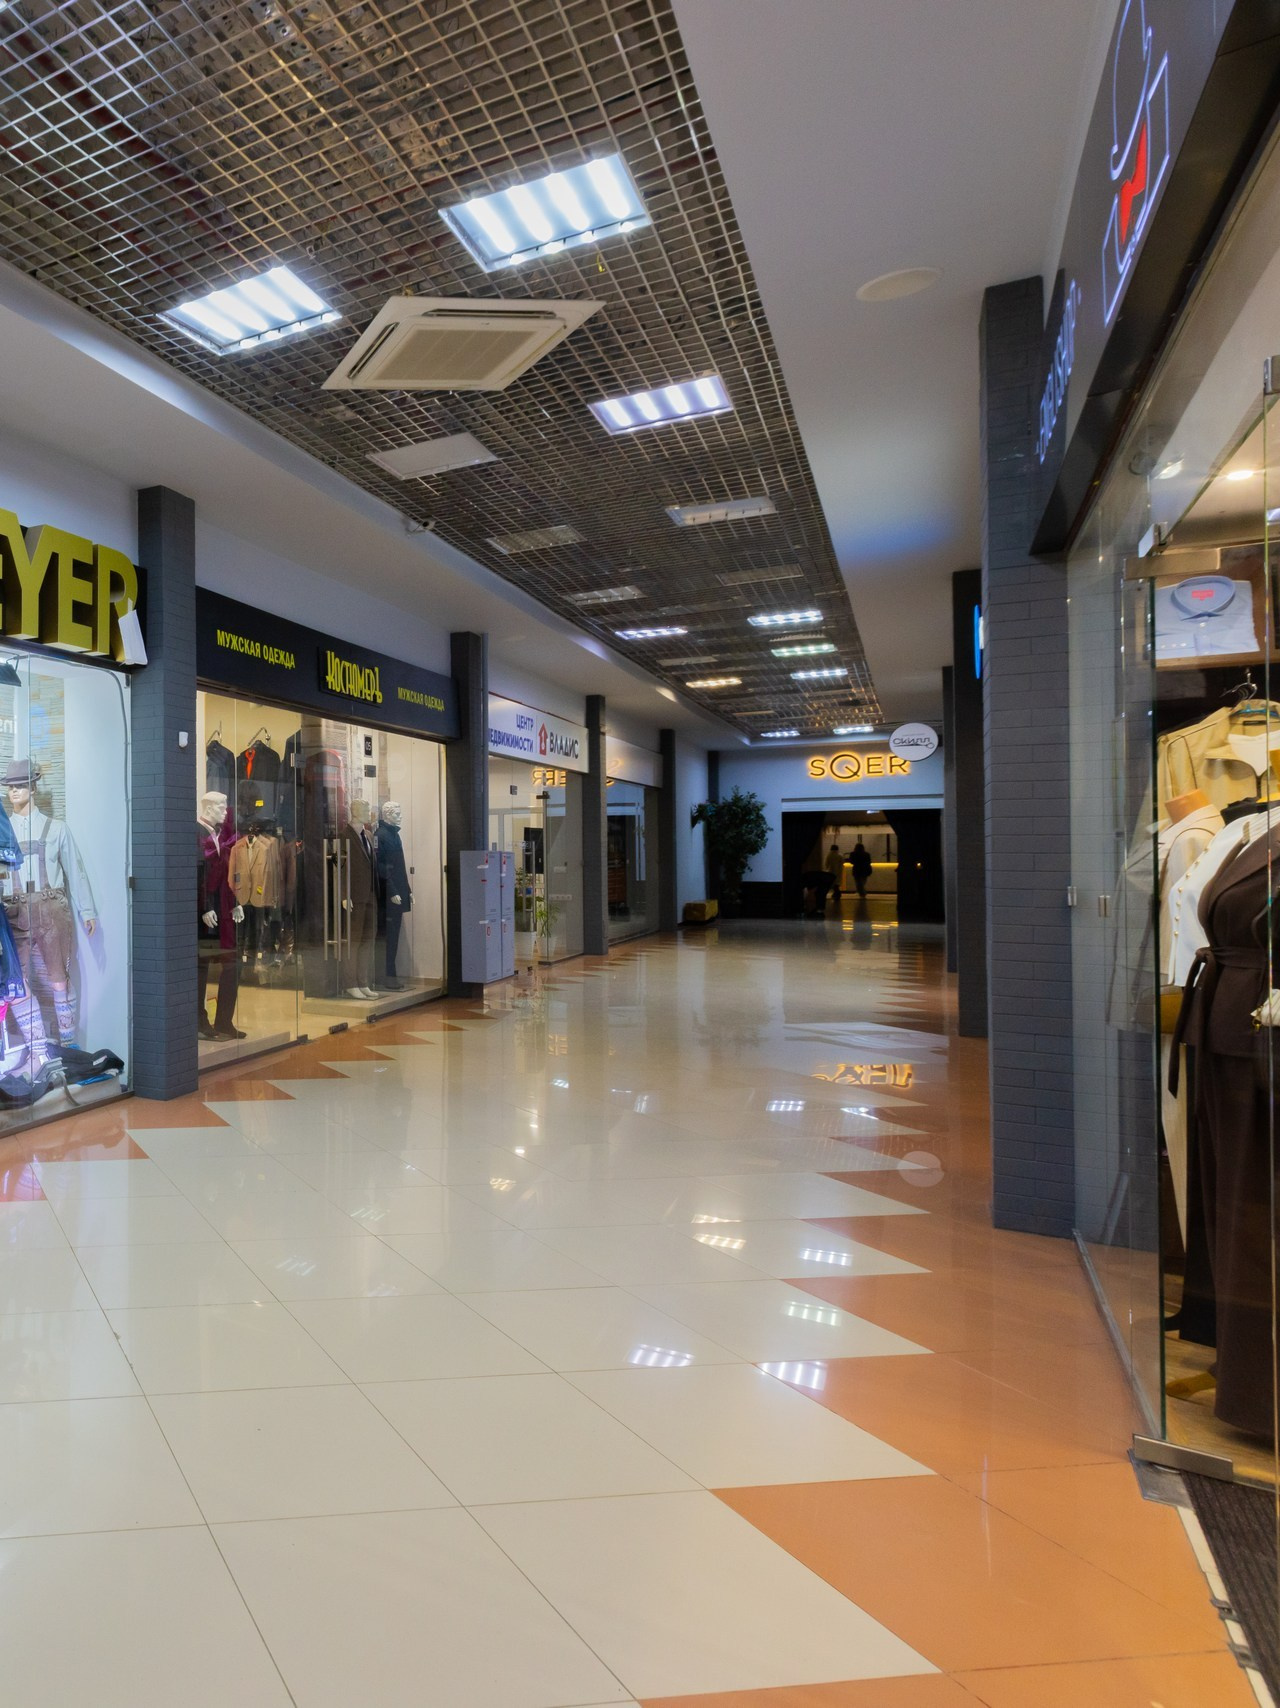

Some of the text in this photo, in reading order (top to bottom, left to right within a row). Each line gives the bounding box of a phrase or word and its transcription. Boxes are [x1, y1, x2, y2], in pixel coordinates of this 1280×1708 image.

[216, 629, 296, 670] МУЖСКАЯ ОДЕЖДА
[397, 687, 445, 712] МУЖСКАЯ ОДЕЖДА
[516, 713, 534, 731] ЦЕНТР
[549, 731, 579, 760] ВЛАДИС
[810, 753, 908, 778] SQER
